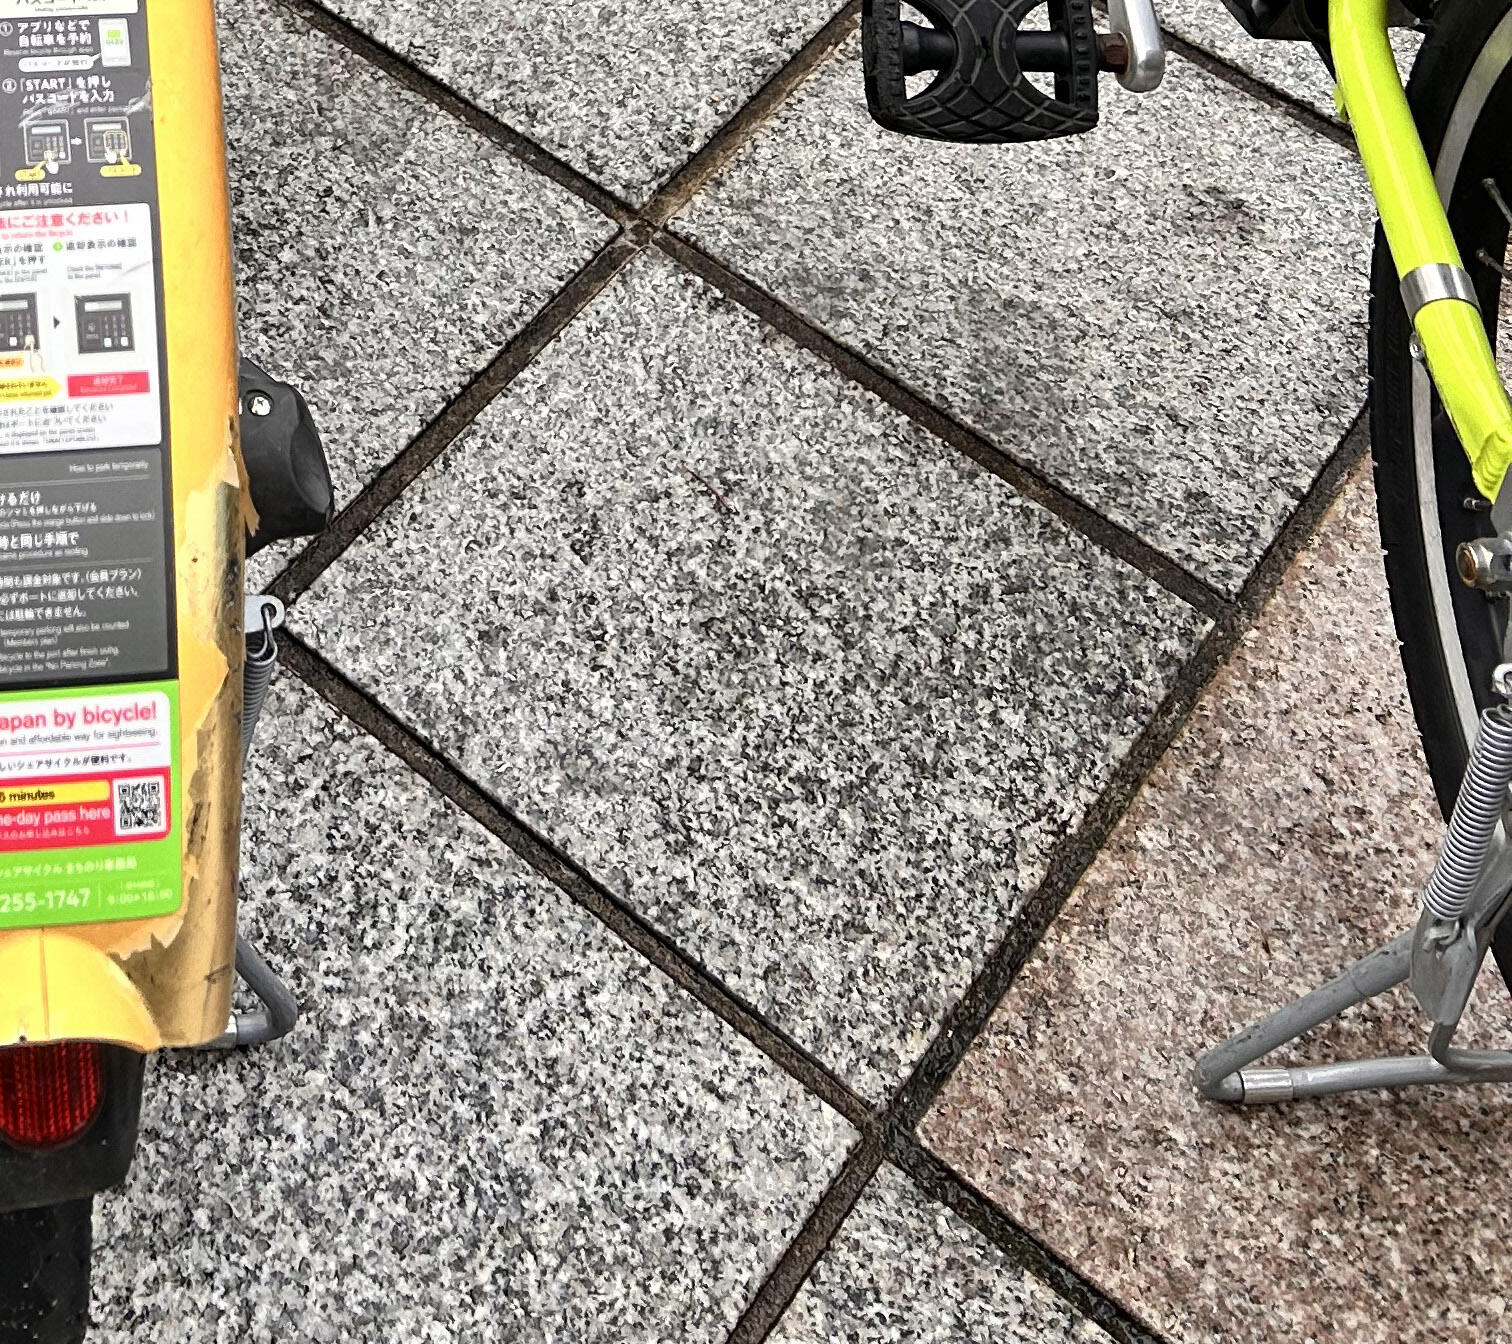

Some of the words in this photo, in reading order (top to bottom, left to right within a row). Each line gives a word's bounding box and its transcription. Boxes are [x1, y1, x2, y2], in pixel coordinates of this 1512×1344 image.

[17, 19, 91, 34] アプリなどで
[53, 707, 77, 730] by
[82, 700, 157, 727] bicycle!
[10, 734, 26, 745] and
[74, 733, 91, 742] way
[93, 729, 104, 739] for
[9, 790, 56, 802] minutes
[44, 810, 77, 826] pass
[79, 805, 111, 820] here
